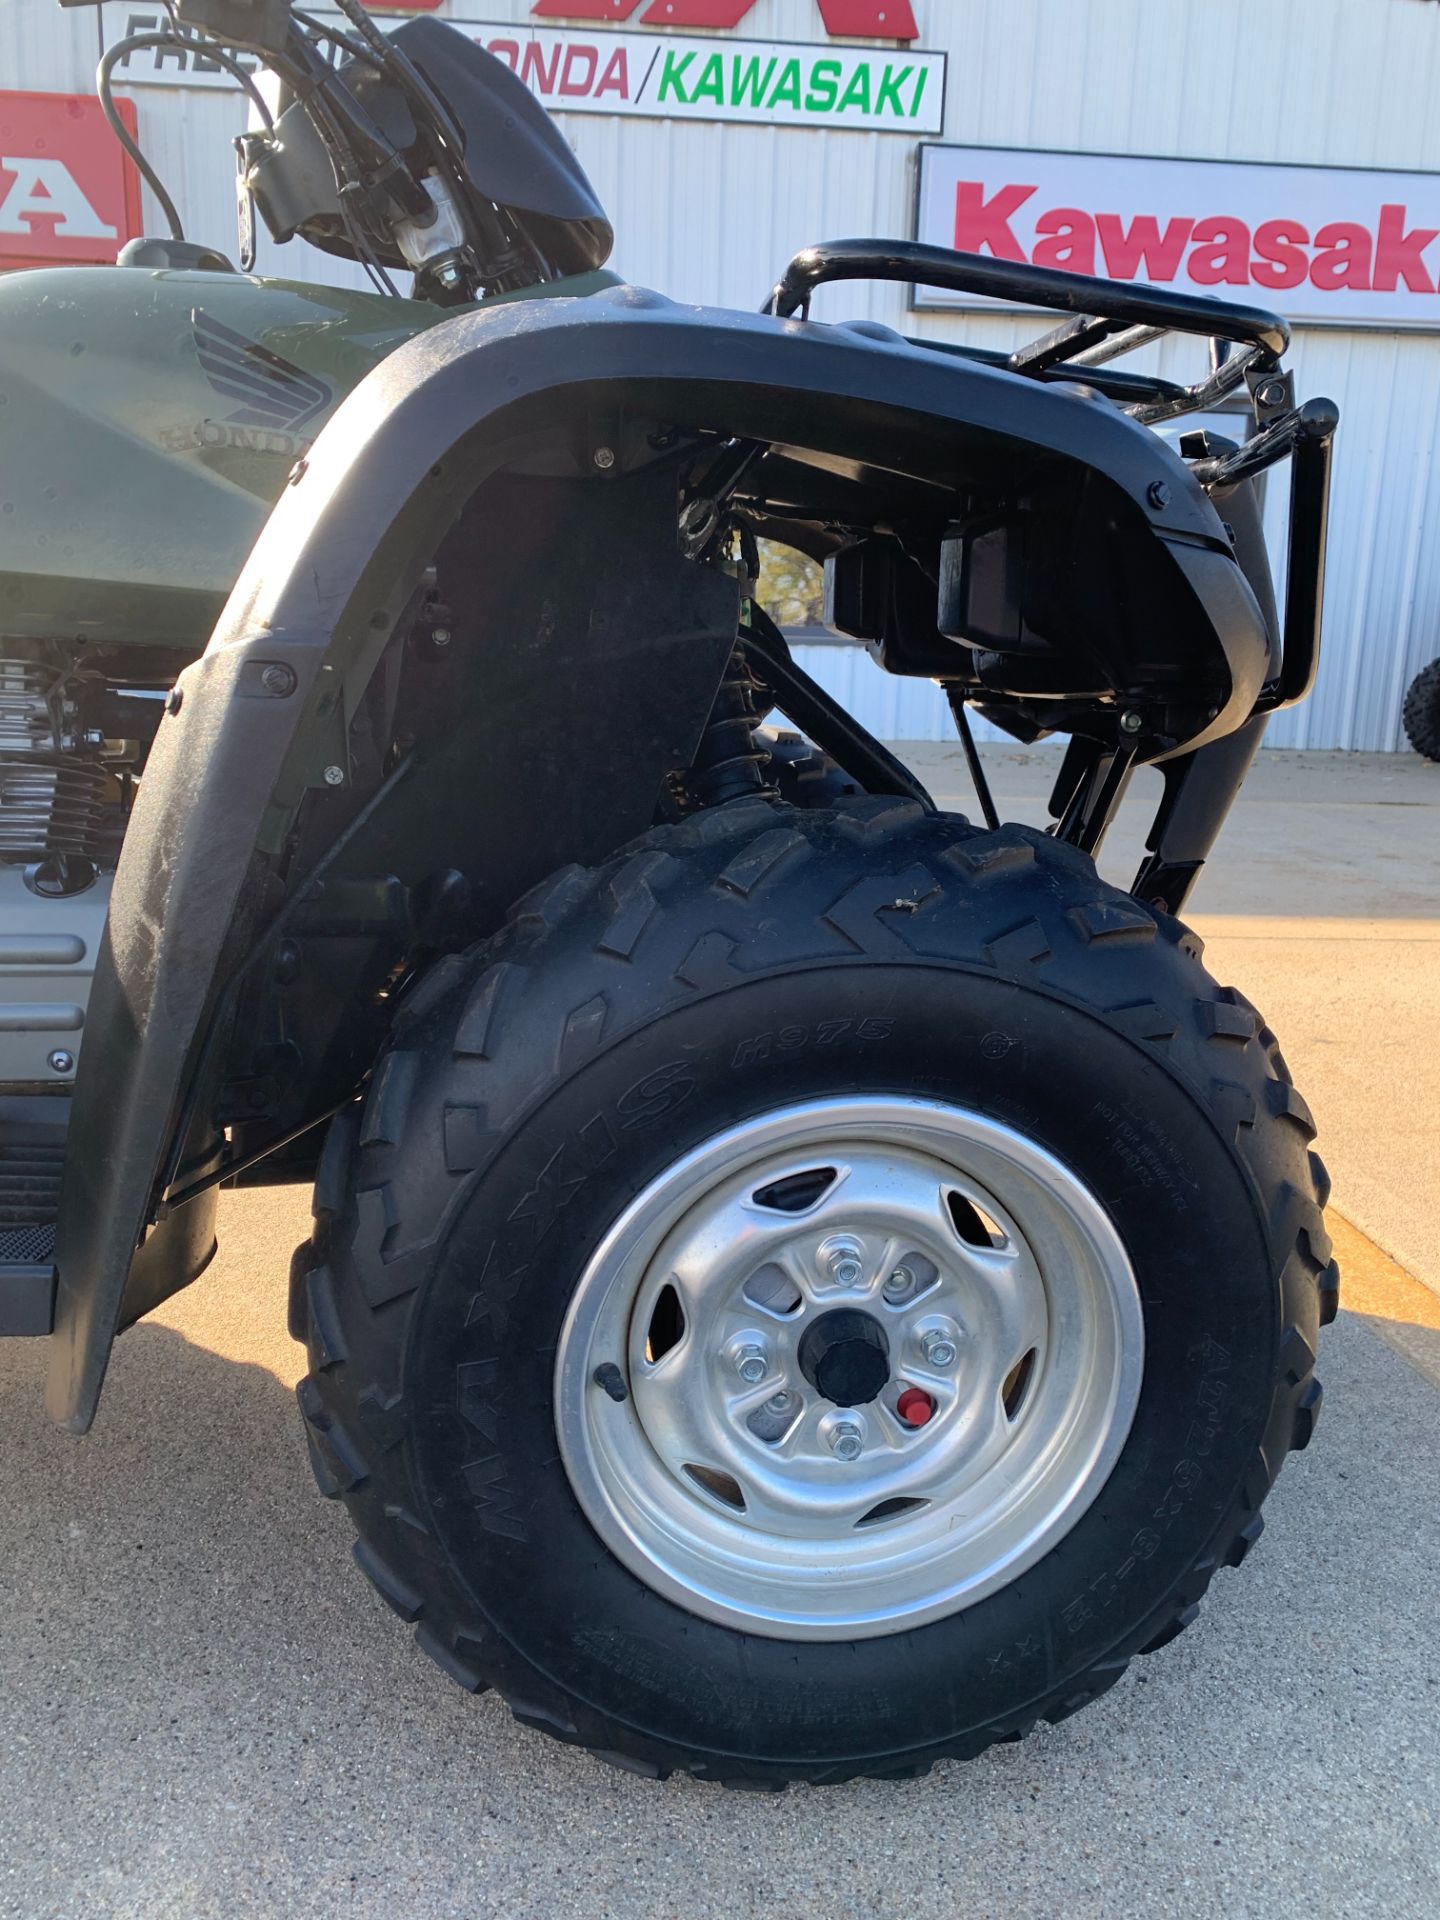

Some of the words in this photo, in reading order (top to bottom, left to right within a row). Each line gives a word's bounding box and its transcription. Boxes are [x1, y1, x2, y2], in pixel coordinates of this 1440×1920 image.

[474, 37, 929, 118] ONDA/KAWASAKI
[955, 181, 1440, 294] Kawasak
[729, 1016, 897, 1069] M975
[1093, 1100, 1120, 1123] NOT
